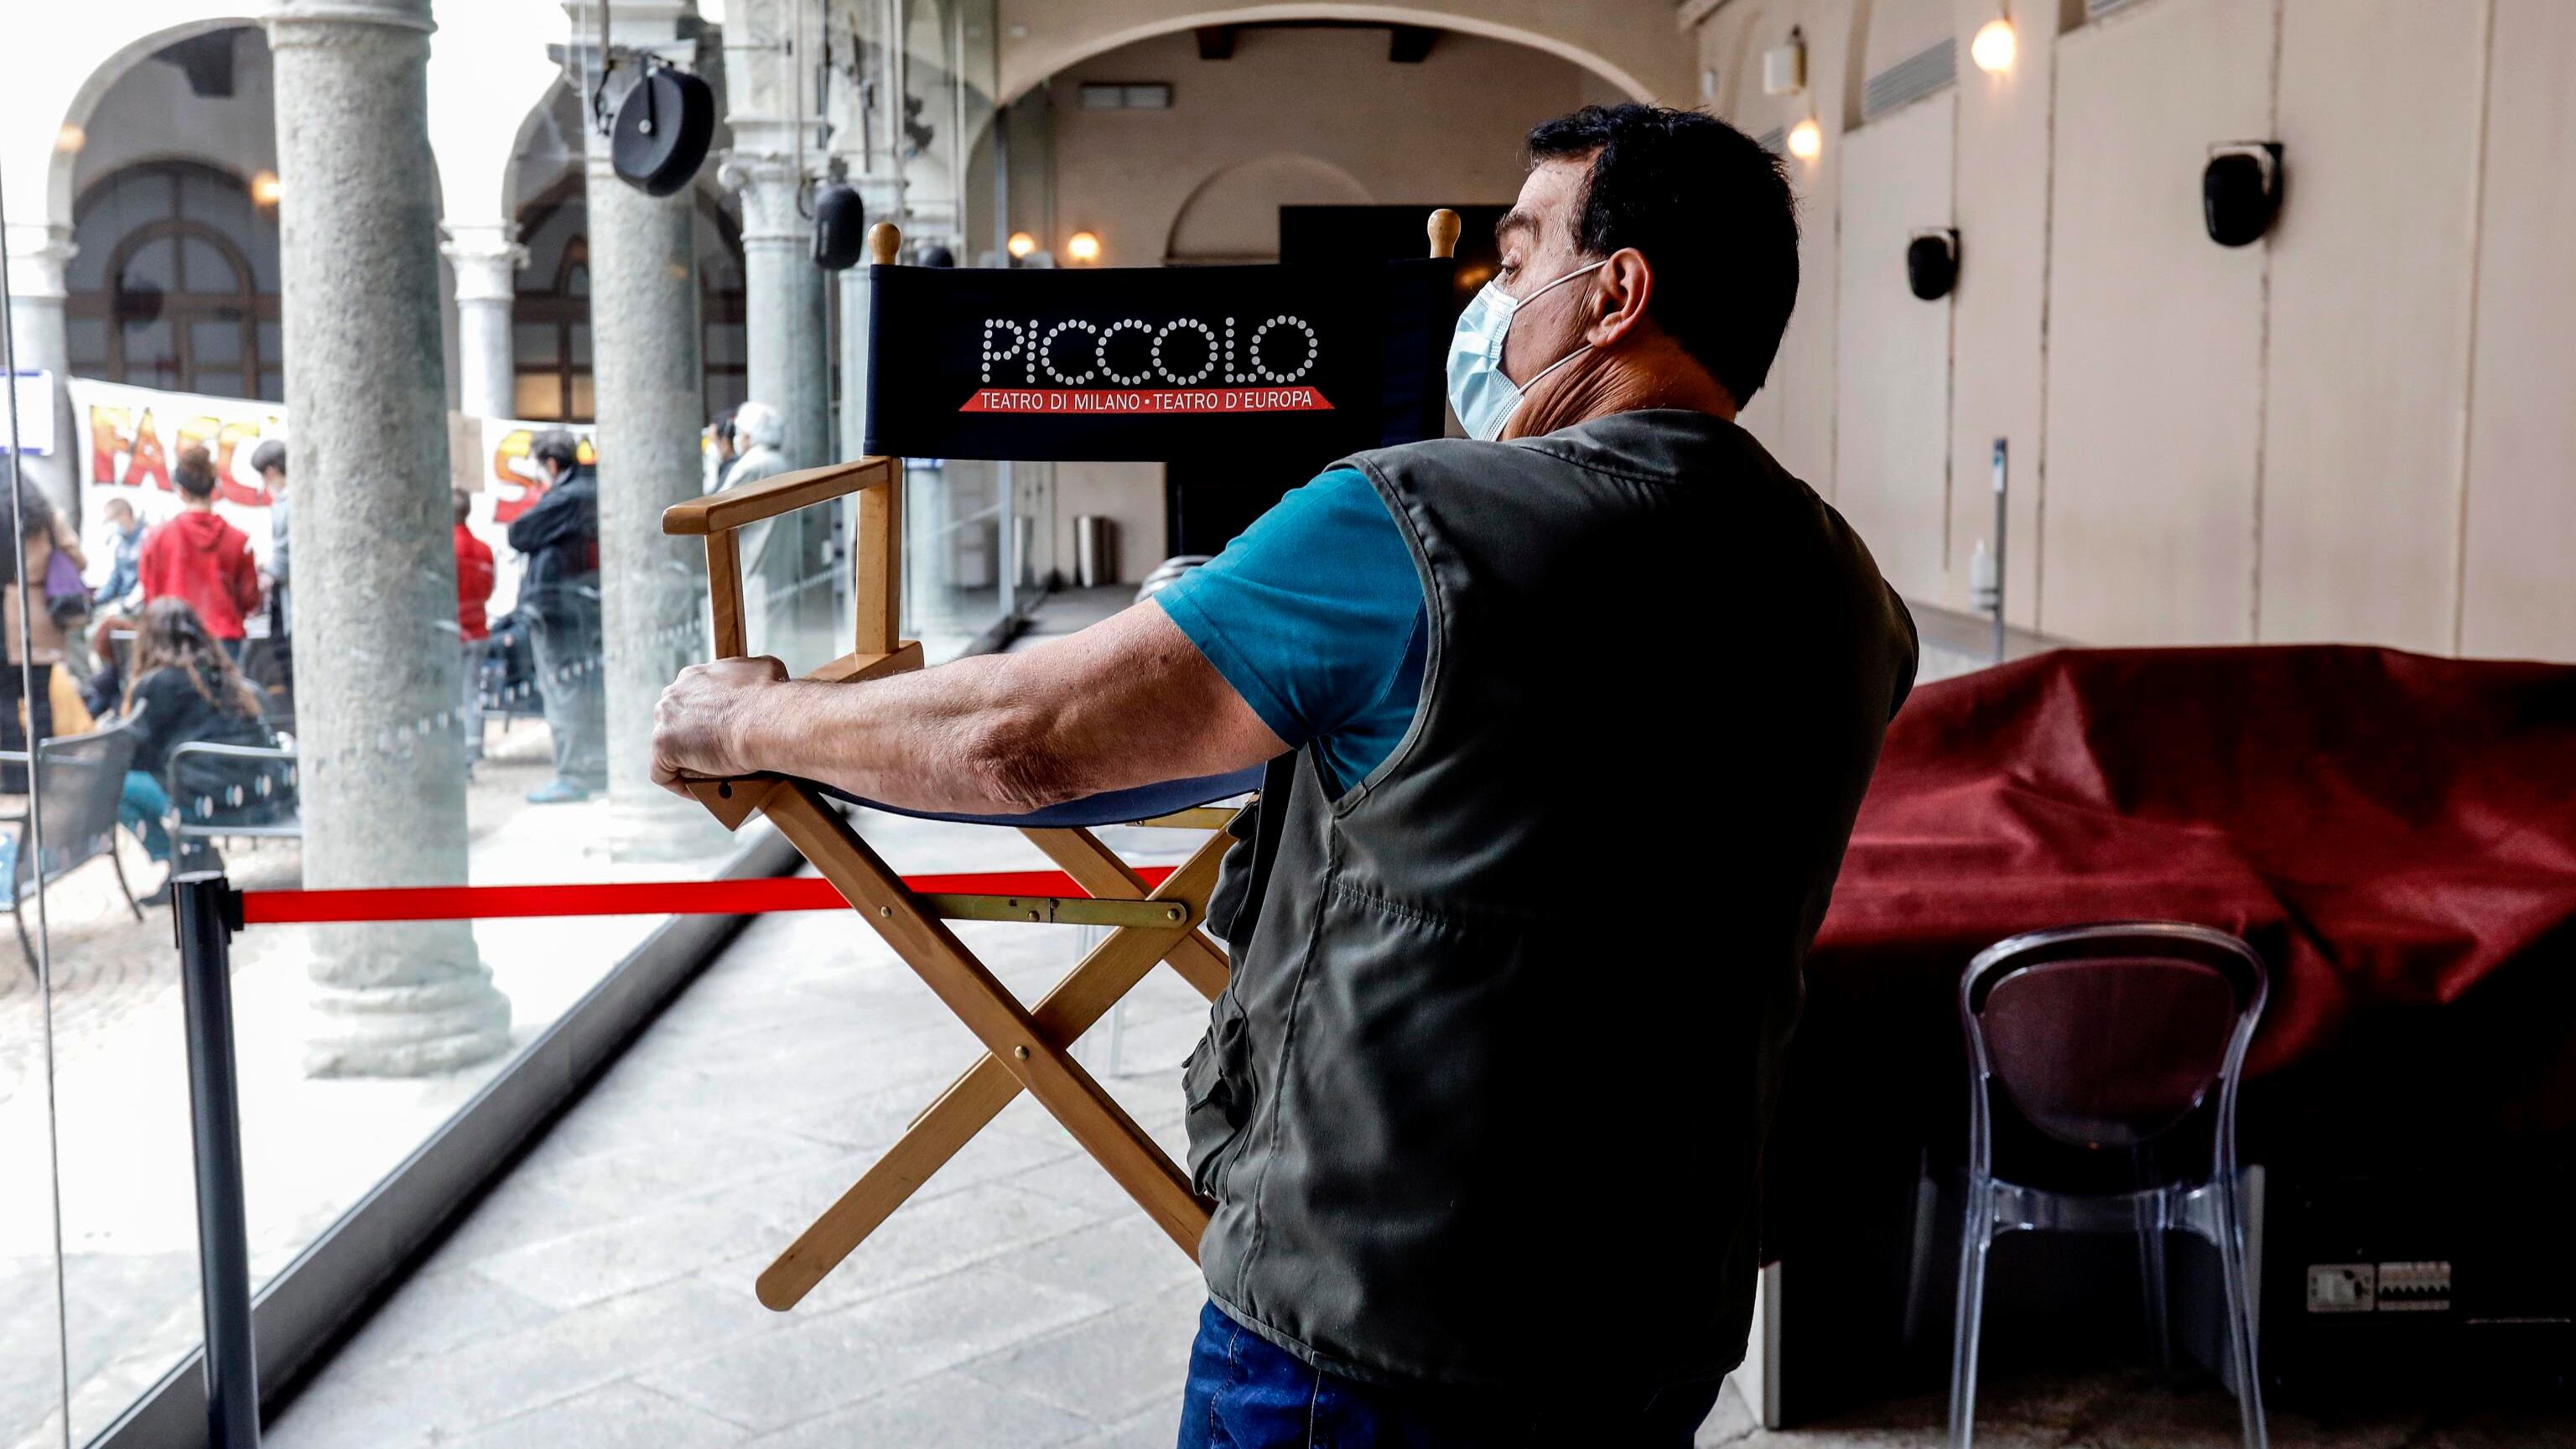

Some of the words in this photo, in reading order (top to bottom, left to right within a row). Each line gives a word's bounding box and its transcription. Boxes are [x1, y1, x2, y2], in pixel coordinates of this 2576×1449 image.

[981, 314, 1318, 386] PICCOLO
[980, 392, 1043, 410] TEATRO
[1050, 393, 1067, 410] DI
[1074, 393, 1140, 410] MILANO
[1153, 392, 1218, 410] TEATRO
[1225, 390, 1312, 409] D'EUROPA
